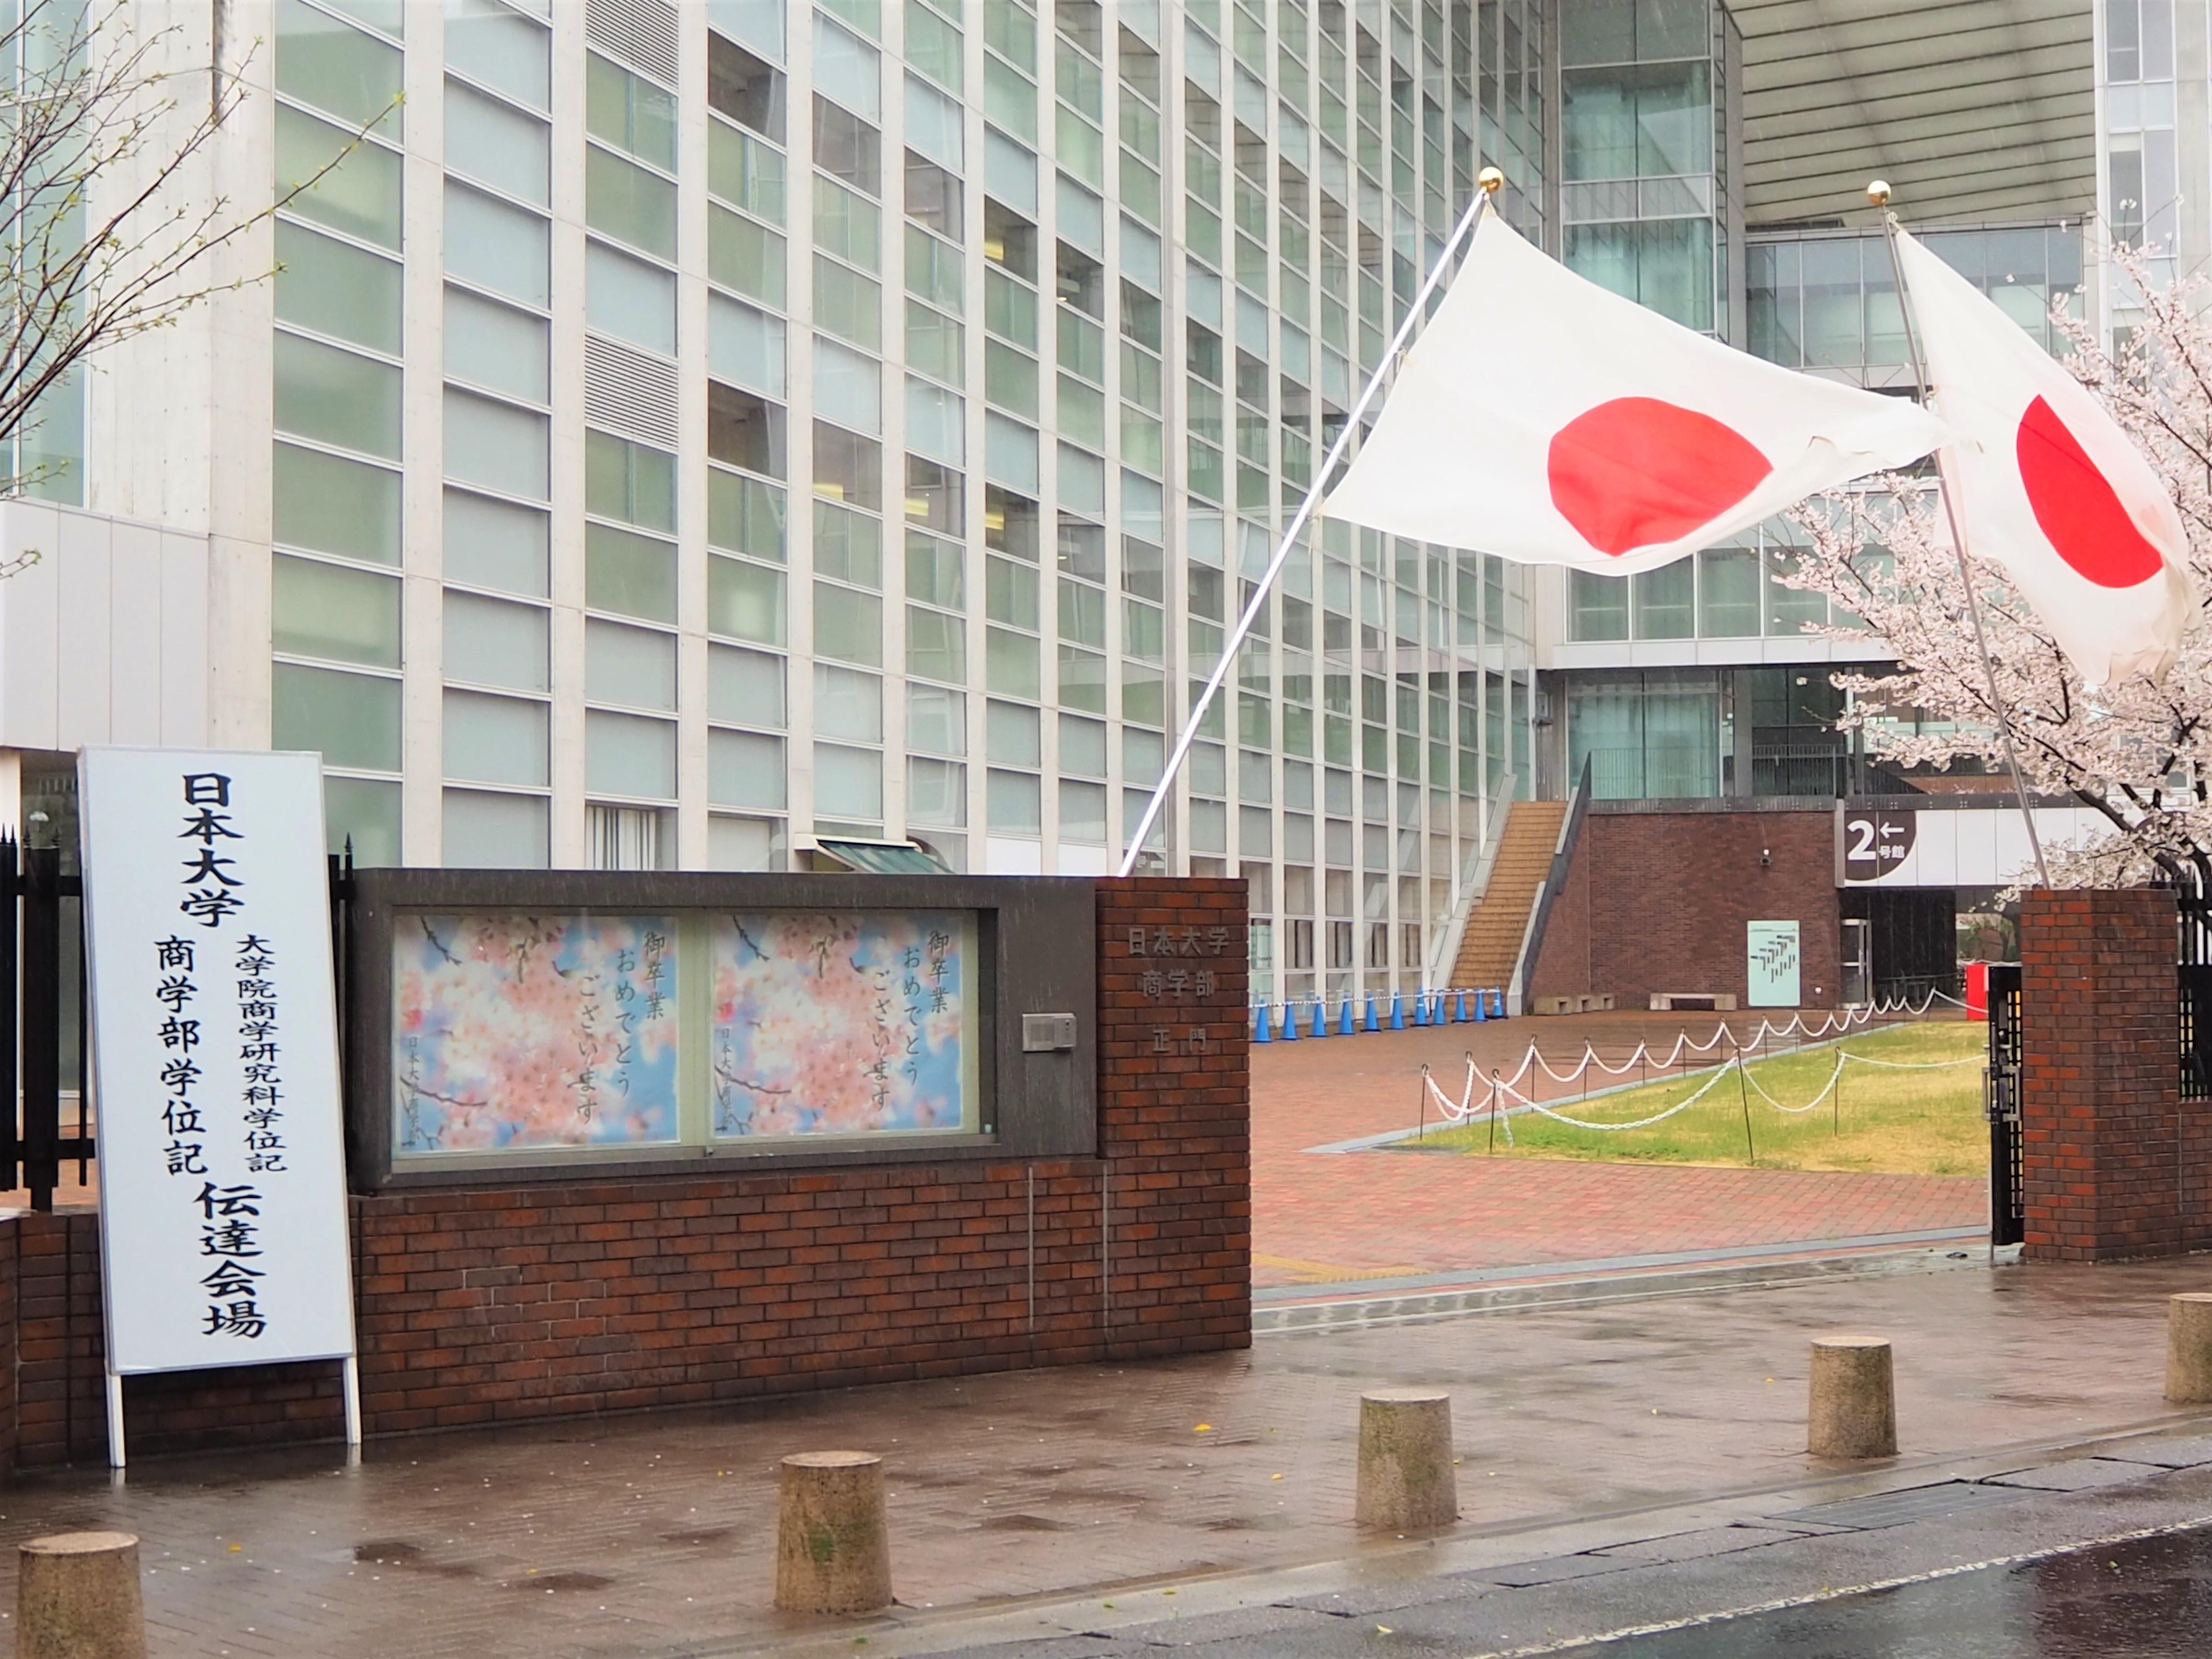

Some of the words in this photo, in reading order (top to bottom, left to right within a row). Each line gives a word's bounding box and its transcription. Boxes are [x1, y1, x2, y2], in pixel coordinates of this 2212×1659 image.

[179, 773, 244, 927] 日本大学
[643, 931, 665, 1020] 御卒業
[928, 930, 949, 1014] 御卒業
[1129, 927, 1229, 955] 日本大学
[1142, 970, 1215, 998] 商学部
[154, 935, 208, 1176] 商学部学位記
[235, 934, 288, 1173] 大学院商学研究科学位記
[577, 974, 600, 1125] ございます
[614, 950, 636, 1097] おめでとう
[871, 969, 891, 1111] ございます
[903, 947, 921, 1087] おめでとう
[193, 1182, 267, 1339] 伝達会場
